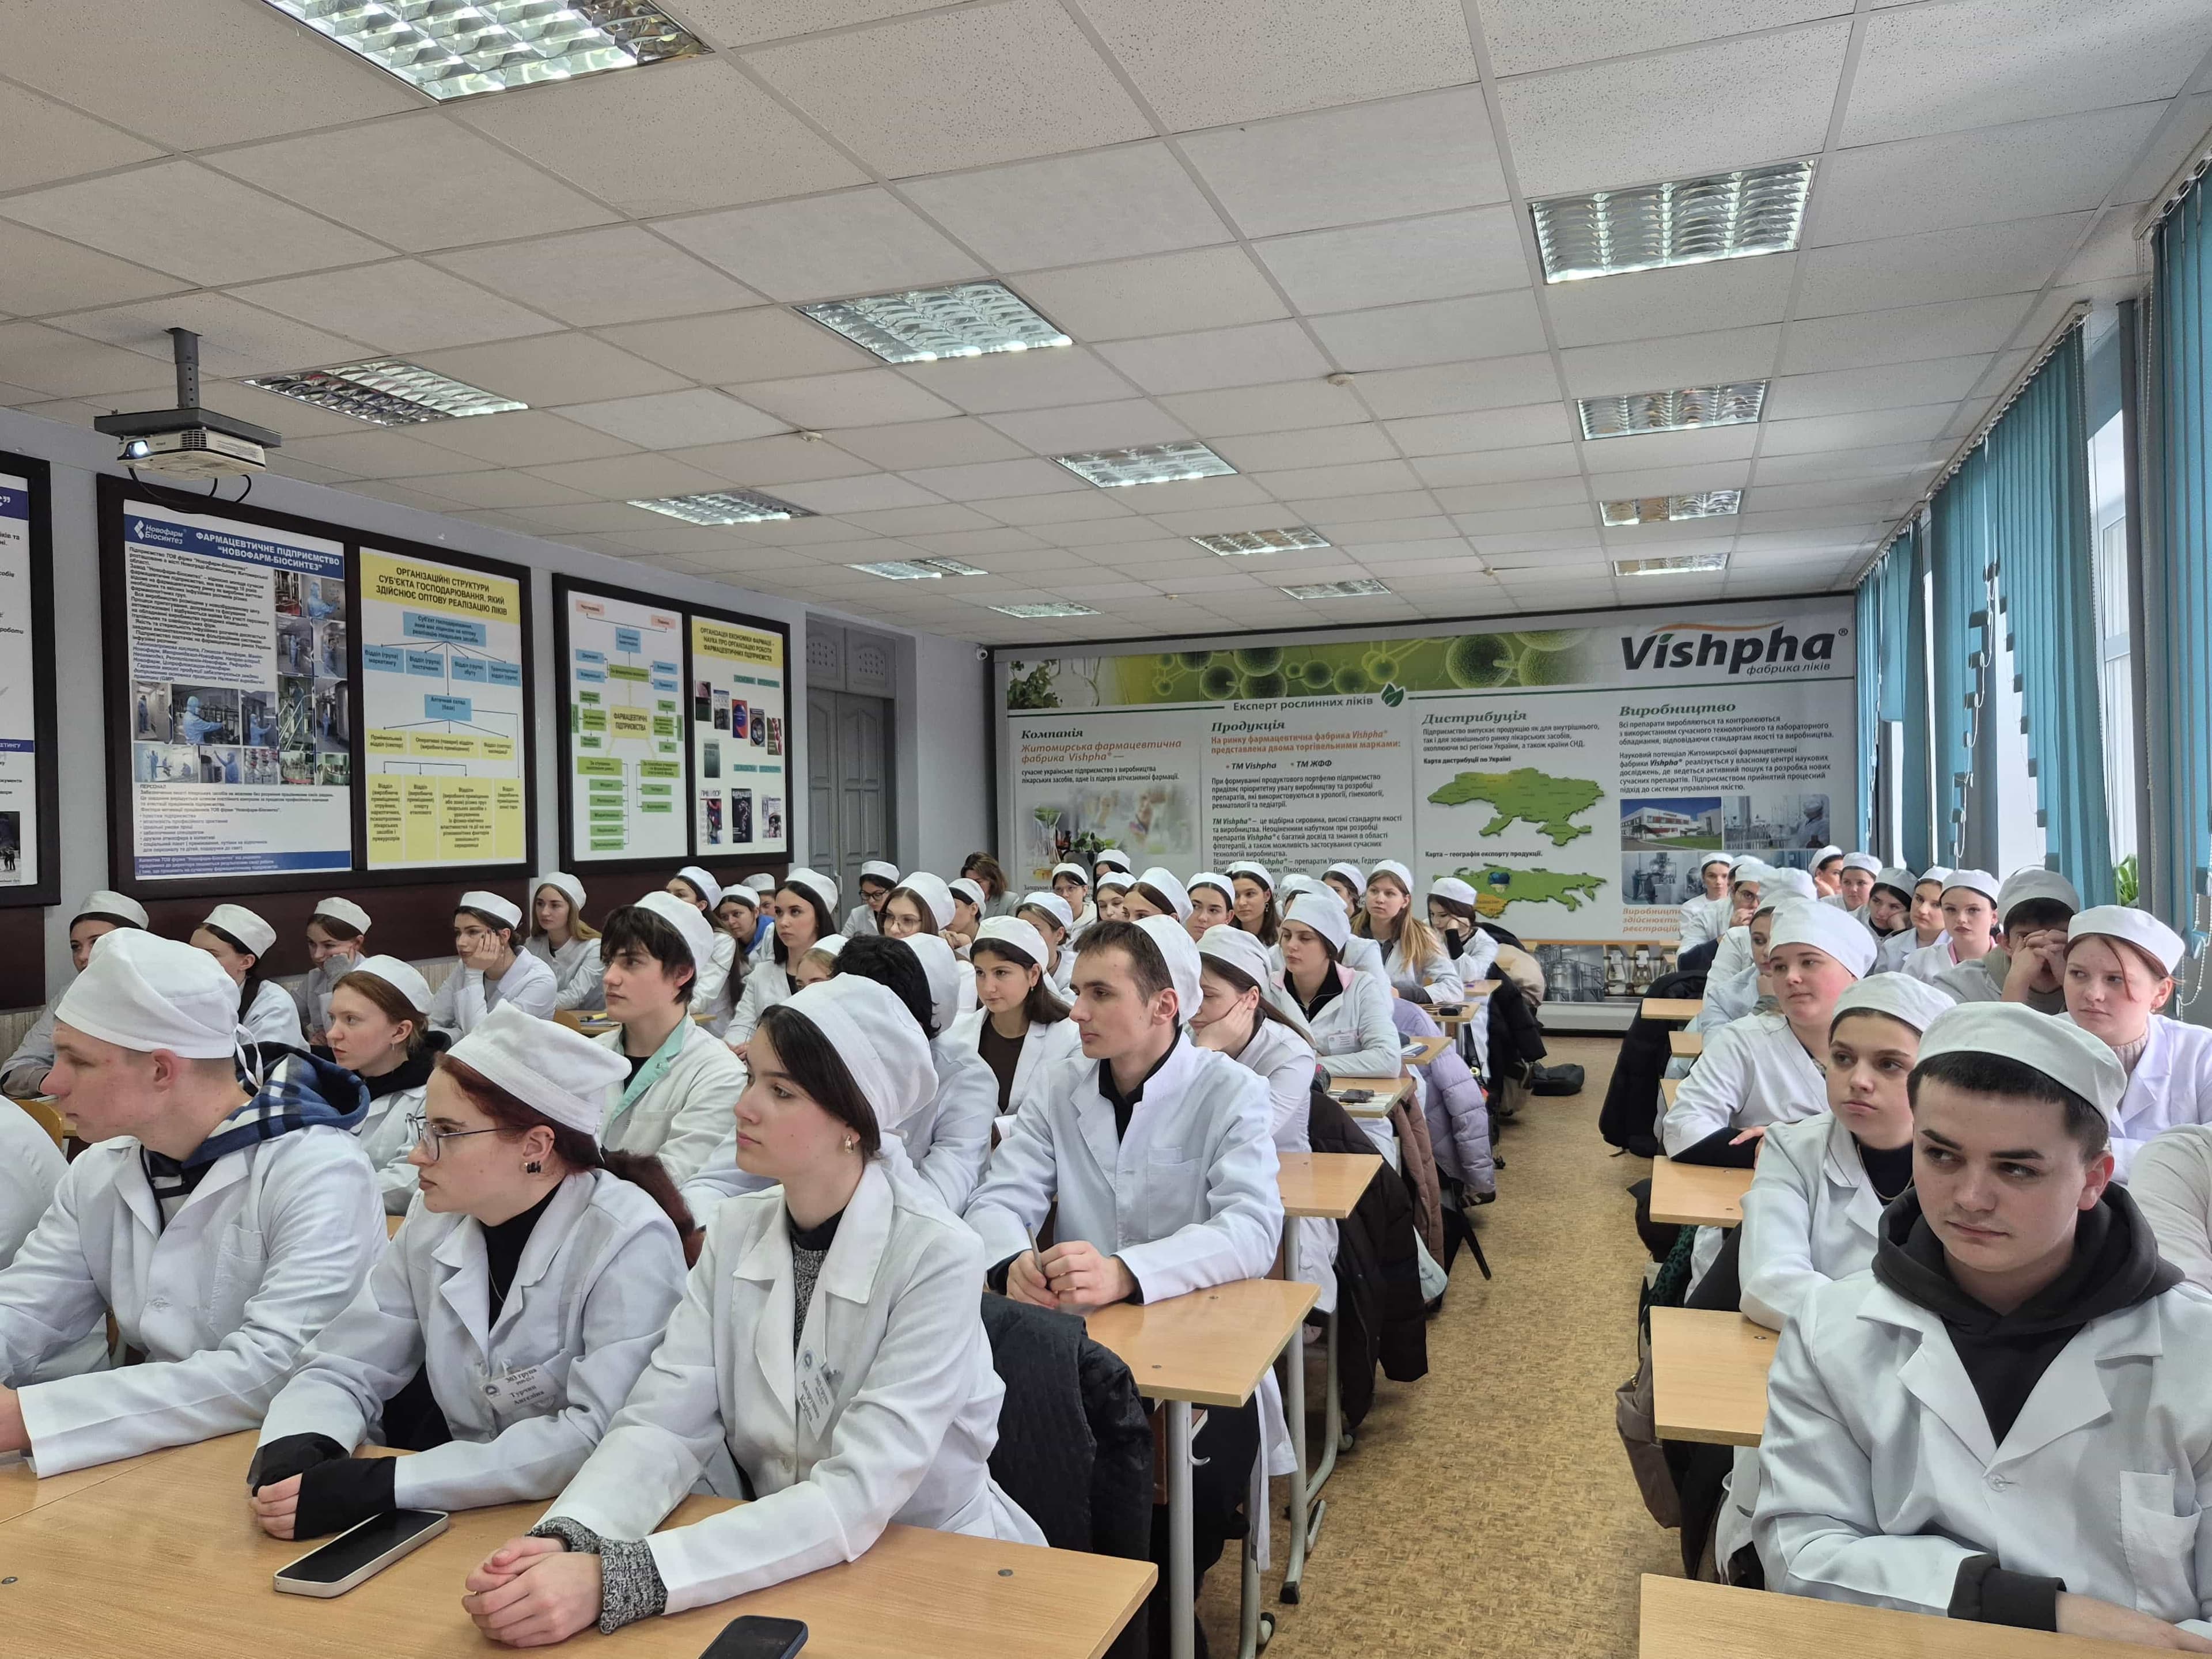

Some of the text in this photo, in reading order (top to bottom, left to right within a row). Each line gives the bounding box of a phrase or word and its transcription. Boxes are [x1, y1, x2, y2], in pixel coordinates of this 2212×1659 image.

[146, 524, 183, 537] Новофарм
[145, 532, 183, 544] Біосинтез
[196, 532, 339, 565] ФАРМАЦЕВТИЧНЕ ПІДПРИЄМСТВО
[396, 567, 489, 592] ОРГАНІЗАЦІЙНІ СТРУКТУРИ
[376, 585, 507, 615] ЗДІЙСНЮЄ ОПТОВУ РЕАЛІЗАЦІЮ ЛІКІВ
[487, 595, 505, 605] ЯКИЙ
[1746, 662, 1830, 676] фабрика ліків
[1233, 696, 1373, 713] Експерт рослинних ліків
[1619, 702, 1736, 718] Виробництво
[1421, 711, 1527, 725] Дистрибуція
[1629, 721, 1665, 729] препарати
[1666, 718, 1715, 728] виробляються
[1725, 717, 1780, 726] контролюються
[1211, 719, 1285, 734] Продукція
[1423, 728, 1466, 737] Підприємство
[1496, 726, 1530, 734] продукцію
[1624, 729, 1676, 738] використанням
[1677, 728, 1711, 736] сучасного
[1713, 724, 1766, 733] технологічного
[1775, 722, 1828, 732] лабораторного
[1021, 728, 1083, 739] Компанія
[1222, 737, 1247, 746] ринку
[1247, 733, 1313, 745] фармацевтична
[1314, 732, 1350, 743] фабрика
[1510, 733, 1545, 743] лікарських
[1662, 735, 1710, 745] відповідаючи
[1710, 736, 1752, 744] стандартам
[1021, 739, 1181, 755] Житомирська фармацевтична
[1211, 747, 1266, 756] представлена
[1268, 745, 1294, 753] двома
[1296, 741, 1358, 753] торгівельними
[1469, 743, 1493, 752] регіони
[1547, 741, 1569, 749] країни
[1021, 753, 1065, 764] фабрика
[1619, 746, 1797, 760] Науковий потенціал Житомирської фармацевтичної
[1245, 762, 1277, 771] Vishpha
[1423, 757, 1441, 766] Карта
[1442, 757, 1479, 765] дистрибуції
[1488, 756, 1511, 764] Україні
[1620, 759, 1648, 768] фабрики
[1684, 757, 1729, 767] реалізується
[1770, 755, 1794, 764] центрі
[1794, 756, 1828, 764] наукових
[1773, 764, 1808, 773] розробка
[1211, 774, 1381, 786] При формуванні продуктового портфелю підприємство
[1691, 774, 1746, 784] Підприємством
[1747, 773, 1786, 782] прийнятий
[1786, 772, 1825, 781] процесний
[1211, 786, 1238, 794] приділяє
[1239, 785, 1276, 794] пріоритетну
[1294, 783, 1335, 792] виробництву
[1344, 782, 1373, 791] розробці
[1257, 793, 1315, 801] використовуються
[1212, 801, 1250, 810] ревматології
[1268, 816, 1294, 825] відбірна
[1449, 851, 1480, 859] географія
